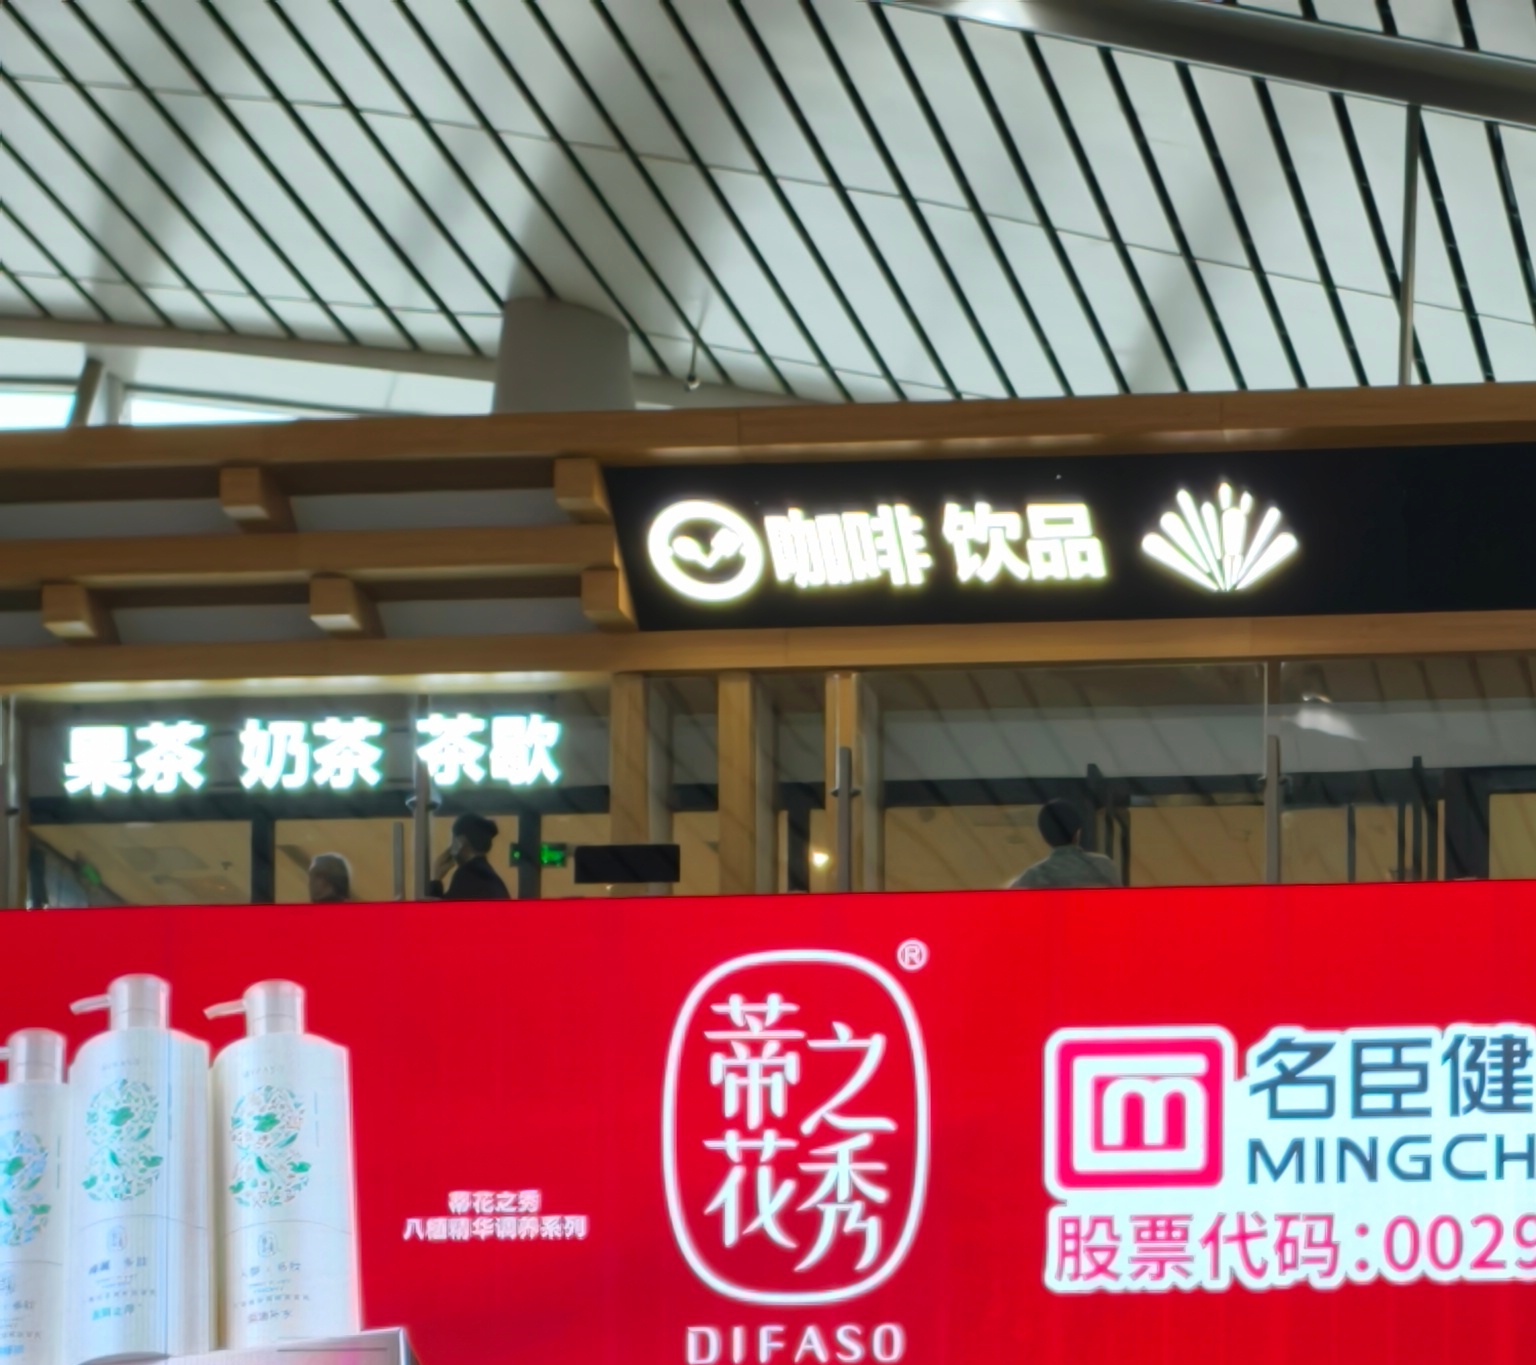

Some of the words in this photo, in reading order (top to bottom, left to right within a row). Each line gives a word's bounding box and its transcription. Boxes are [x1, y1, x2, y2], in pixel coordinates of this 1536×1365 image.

[764, 504, 931, 588] 咖啡
[942, 501, 1107, 583] 饮品
[64, 722, 206, 797] 果茶
[240, 716, 384, 791] 奶茶
